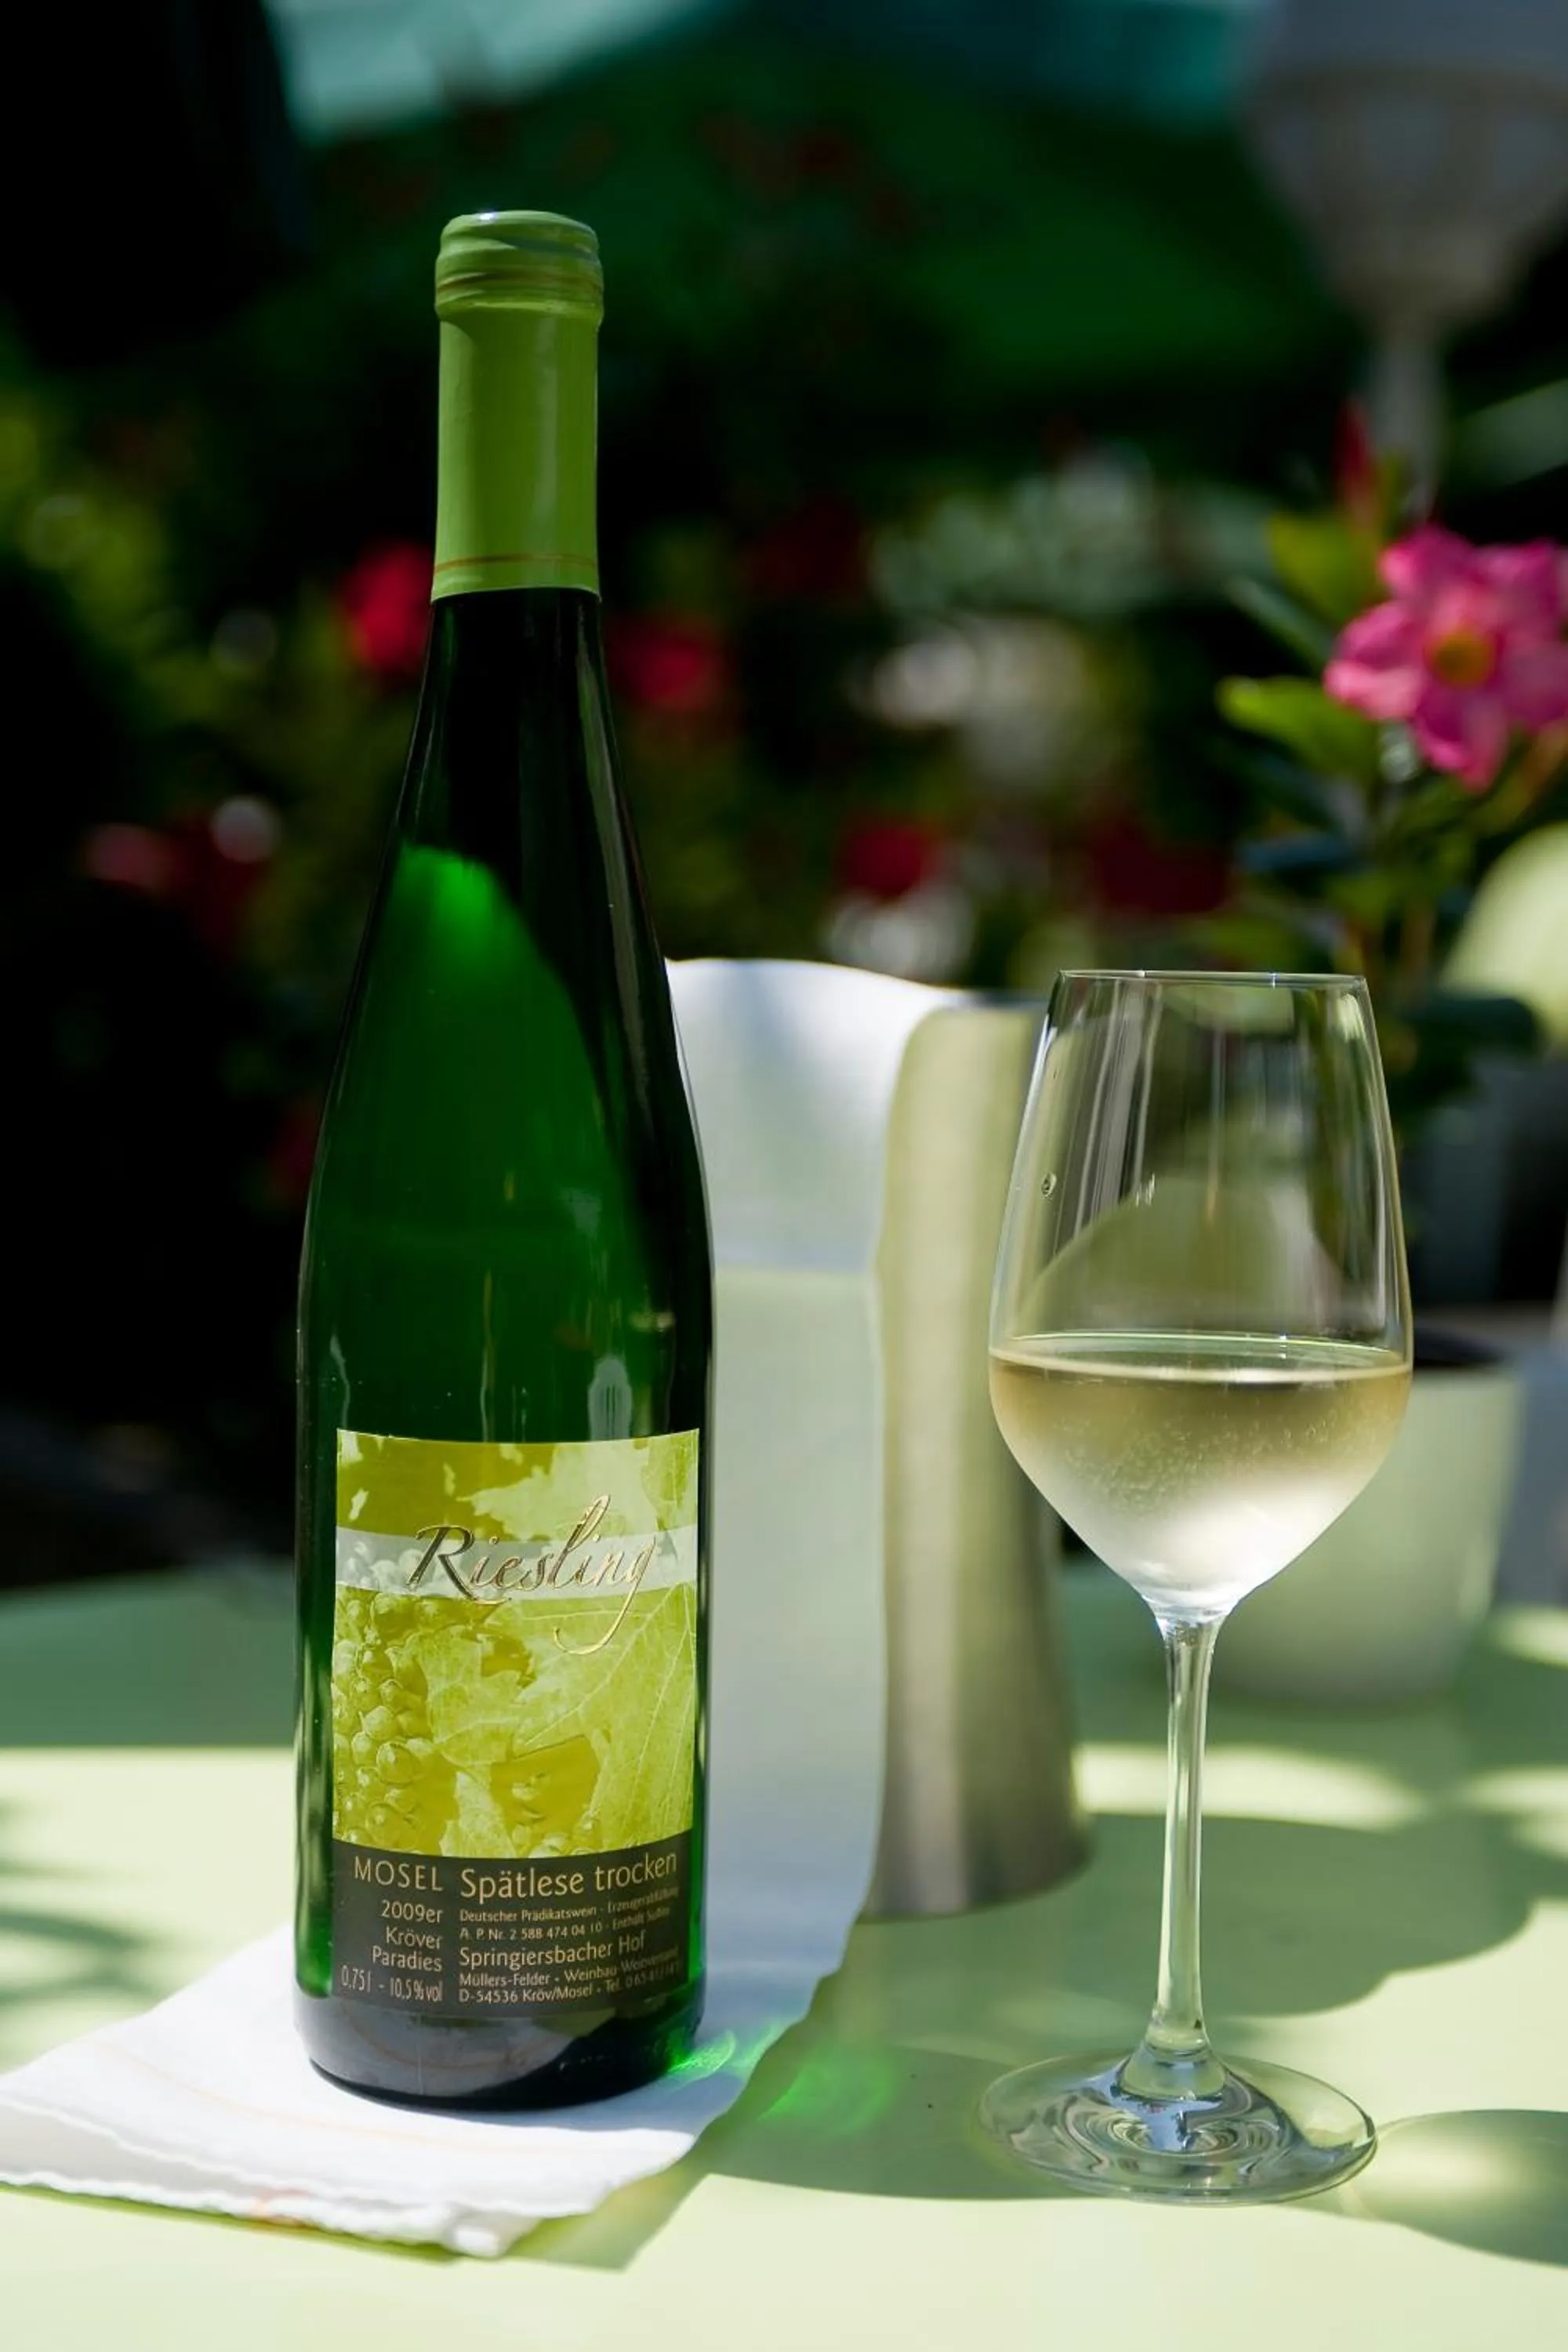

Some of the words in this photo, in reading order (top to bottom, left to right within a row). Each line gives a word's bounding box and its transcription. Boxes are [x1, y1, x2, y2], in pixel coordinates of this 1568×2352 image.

[405, 1494, 657, 1656] Riesling
[354, 1856, 444, 1891] MOSEL
[460, 1867, 584, 1905] Spätlese
[595, 1853, 677, 1893] trocken
[381, 1899, 444, 1923] 2009er
[459, 1908, 517, 1922] Deutscher
[386, 1925, 442, 1949] Kröver
[459, 1940, 613, 1971] Springiersbacher
[618, 1929, 647, 1954] Hof
[372, 1945, 442, 1972] Paradies
[459, 1987, 518, 2004] D-54536
